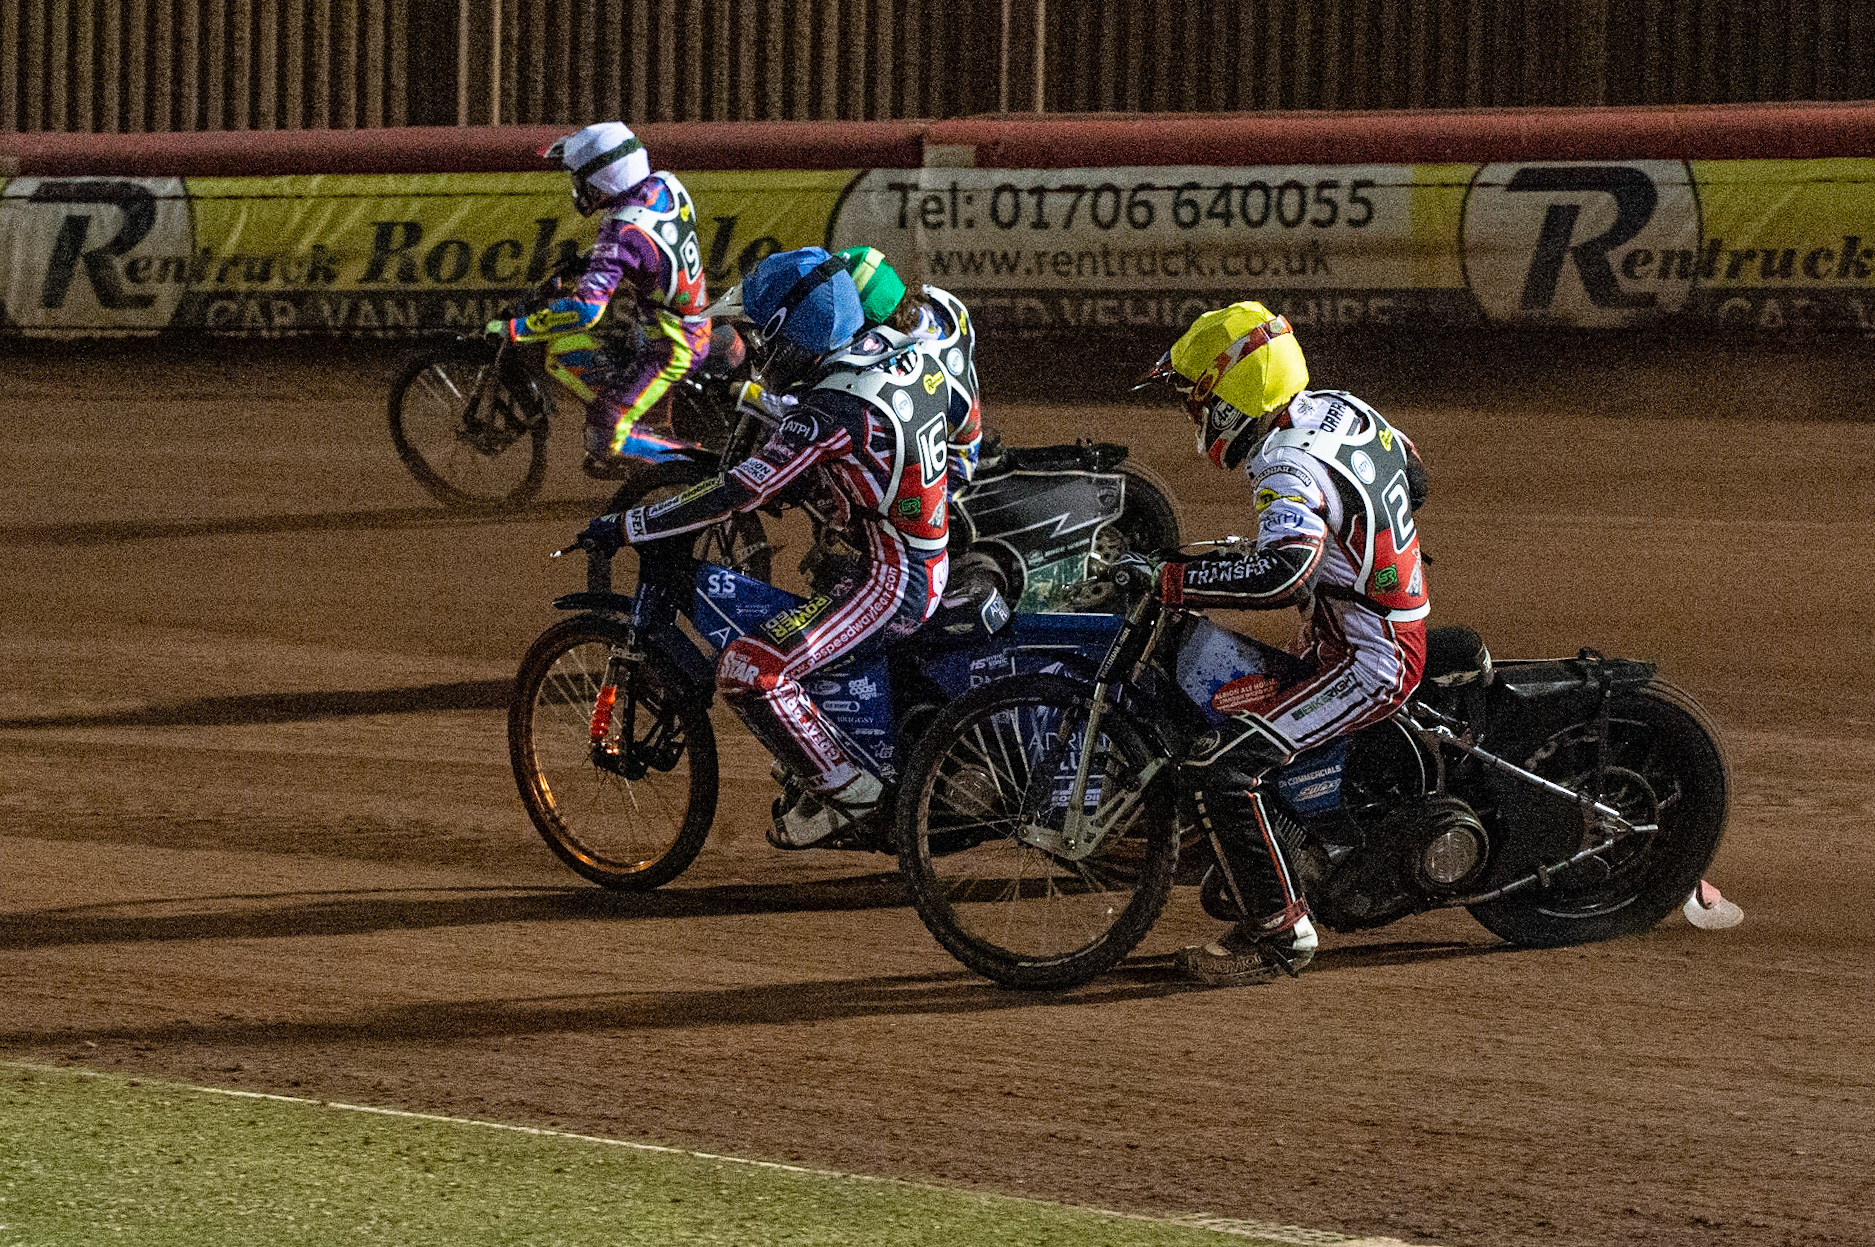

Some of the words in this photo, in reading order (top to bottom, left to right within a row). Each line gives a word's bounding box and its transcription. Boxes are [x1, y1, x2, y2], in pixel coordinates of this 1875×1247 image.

[888, 182, 975, 229] Tel:
[990, 181, 1155, 230] 01706
[1173, 179, 1375, 229] 640055
[28, 178, 342, 311] Rentruck
[686, 241, 700, 272] 9
[928, 238, 1333, 278] www.rentruck.co.uk
[1507, 166, 1874, 311] Rentruck
[785, 420, 812, 438] ATPI
[919, 420, 947, 480] 16
[1388, 484, 1414, 542] 2
[1302, 673, 1356, 716] BIKERIGHT
[1287, 765, 1343, 787] COMMERCIALS
